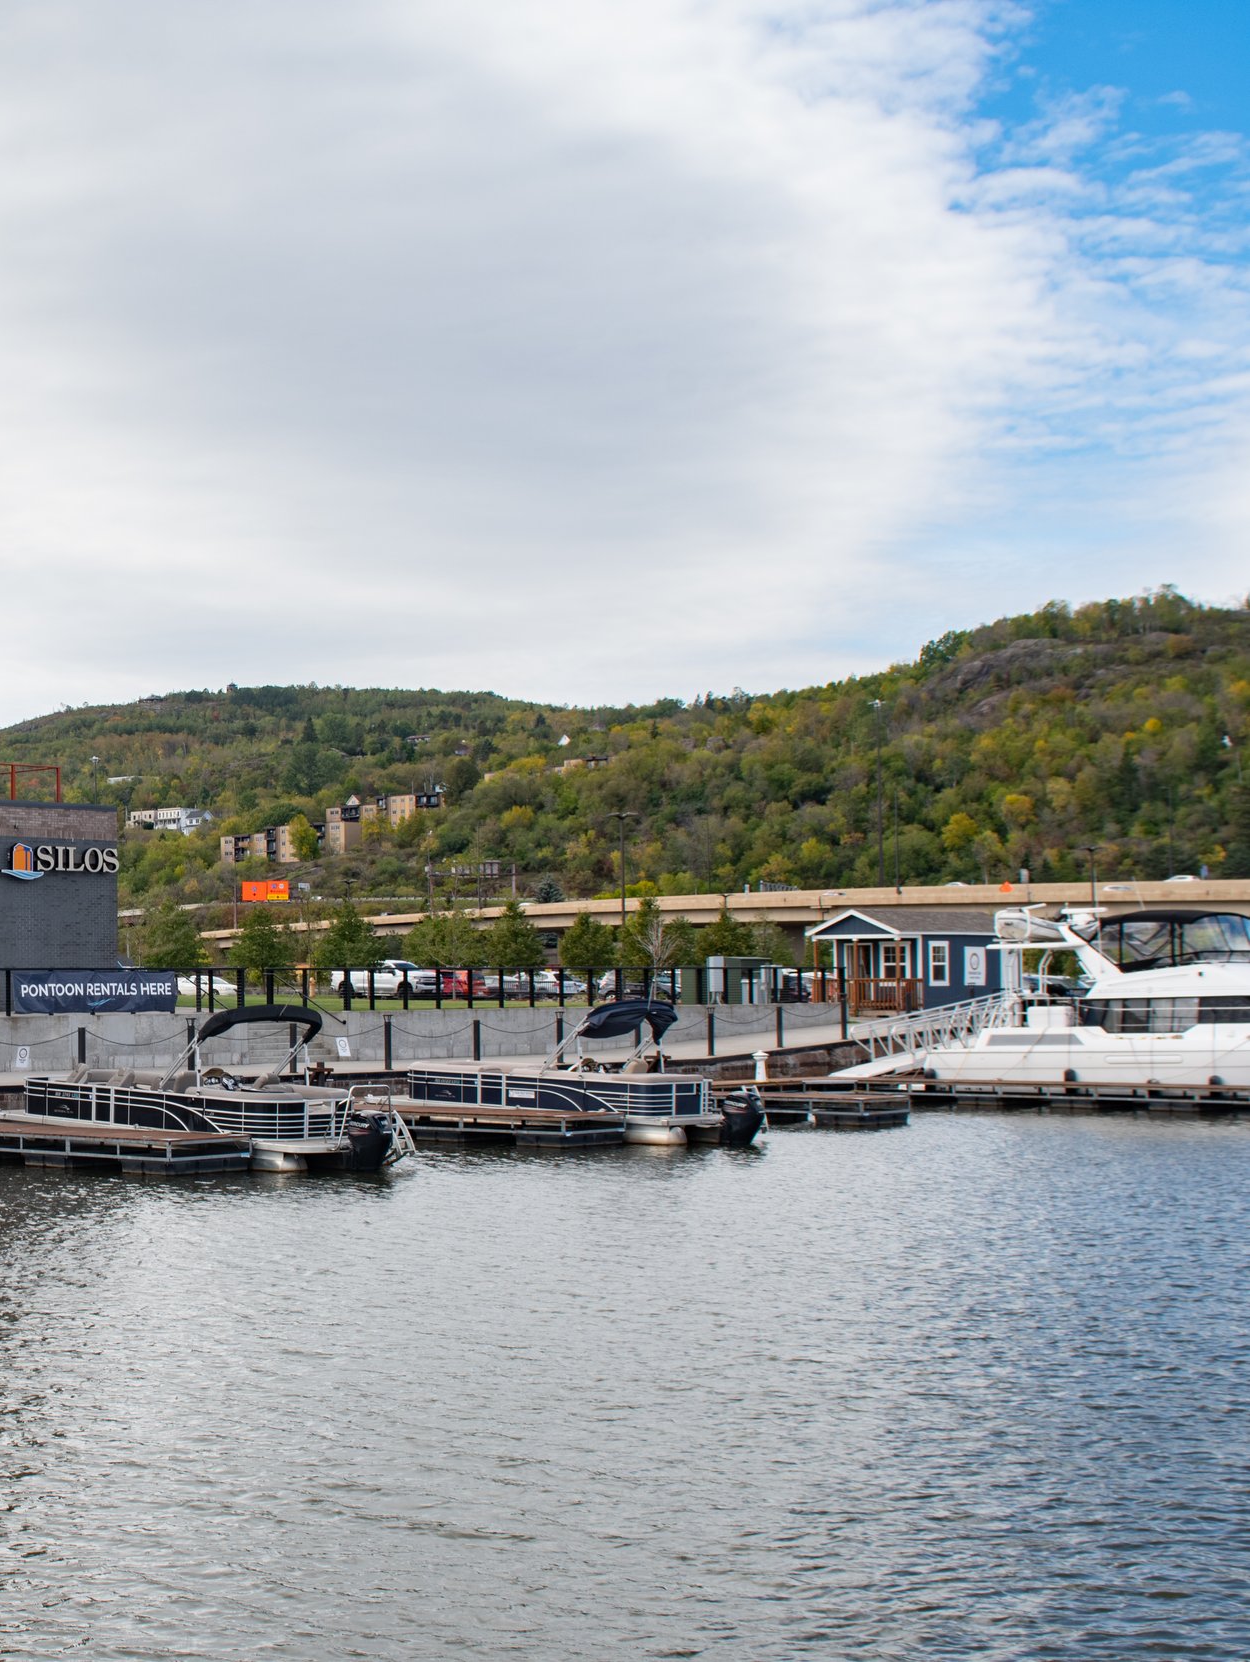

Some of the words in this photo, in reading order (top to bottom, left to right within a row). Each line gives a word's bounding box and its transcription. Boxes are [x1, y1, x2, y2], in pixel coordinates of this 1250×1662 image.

[36, 845, 120, 873] SILOS
[20, 984, 84, 998] PONTOON
[86, 983, 137, 996] RENTALS
[140, 982, 172, 996] HERE
